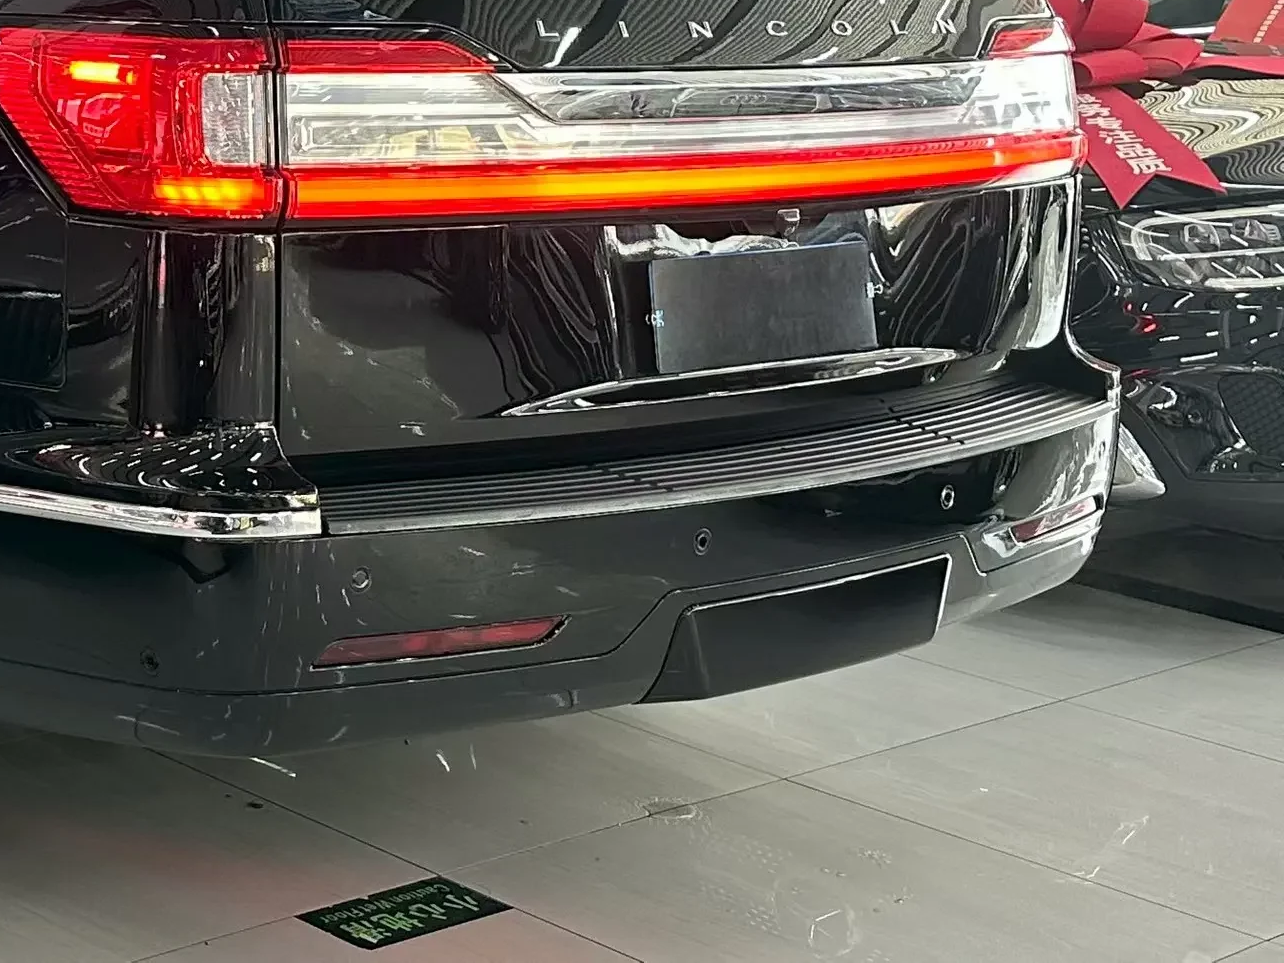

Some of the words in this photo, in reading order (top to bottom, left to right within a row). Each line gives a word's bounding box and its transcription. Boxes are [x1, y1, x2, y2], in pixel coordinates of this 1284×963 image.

[536, 14, 956, 40] LINCOLN
[390, 883, 451, 905] Caution
[319, 905, 363, 924] Floor
[360, 896, 394, 915] Wet
[338, 893, 480, 944] 小心地滑
